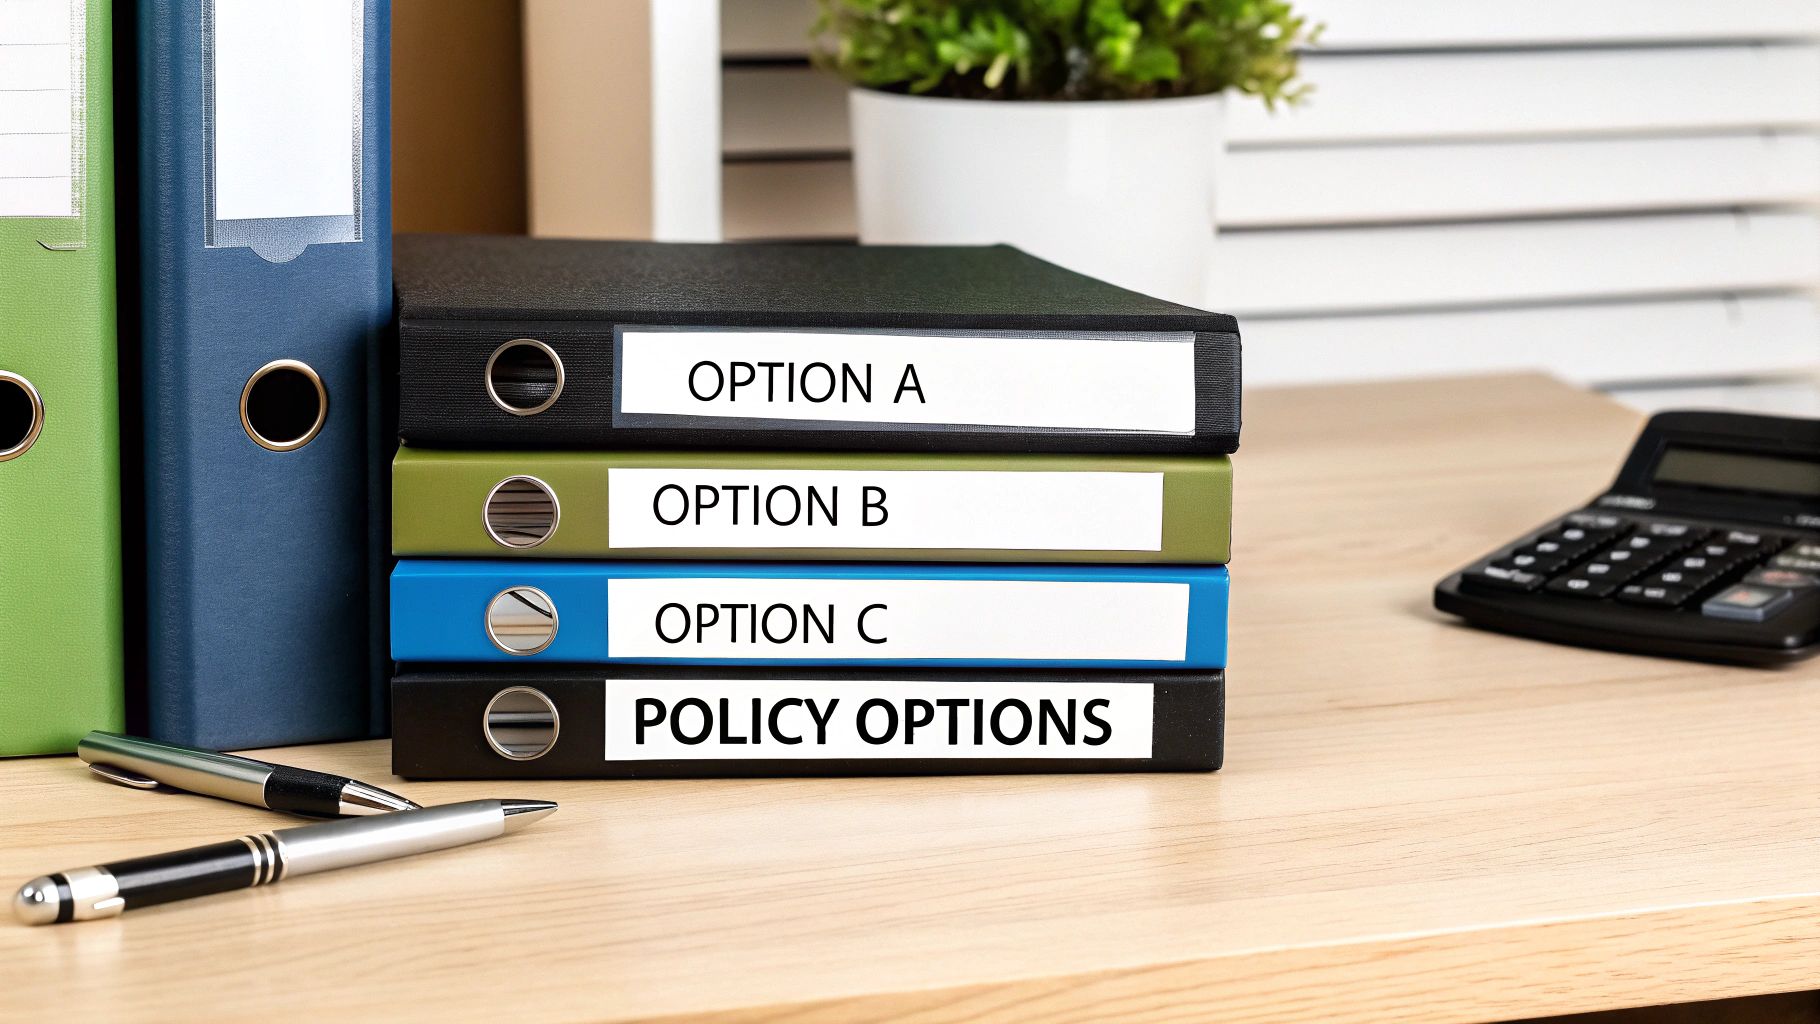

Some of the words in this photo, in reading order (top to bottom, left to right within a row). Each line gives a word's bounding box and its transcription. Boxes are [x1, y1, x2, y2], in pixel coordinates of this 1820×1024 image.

[688, 360, 872, 403] OPTION
[893, 363, 926, 404] A
[652, 483, 838, 527] OPTION
[861, 485, 889, 527] B
[655, 602, 835, 645] OPTION
[857, 603, 888, 645] C
[635, 697, 840, 746] POLICY
[856, 697, 1113, 746] OPTIONS
